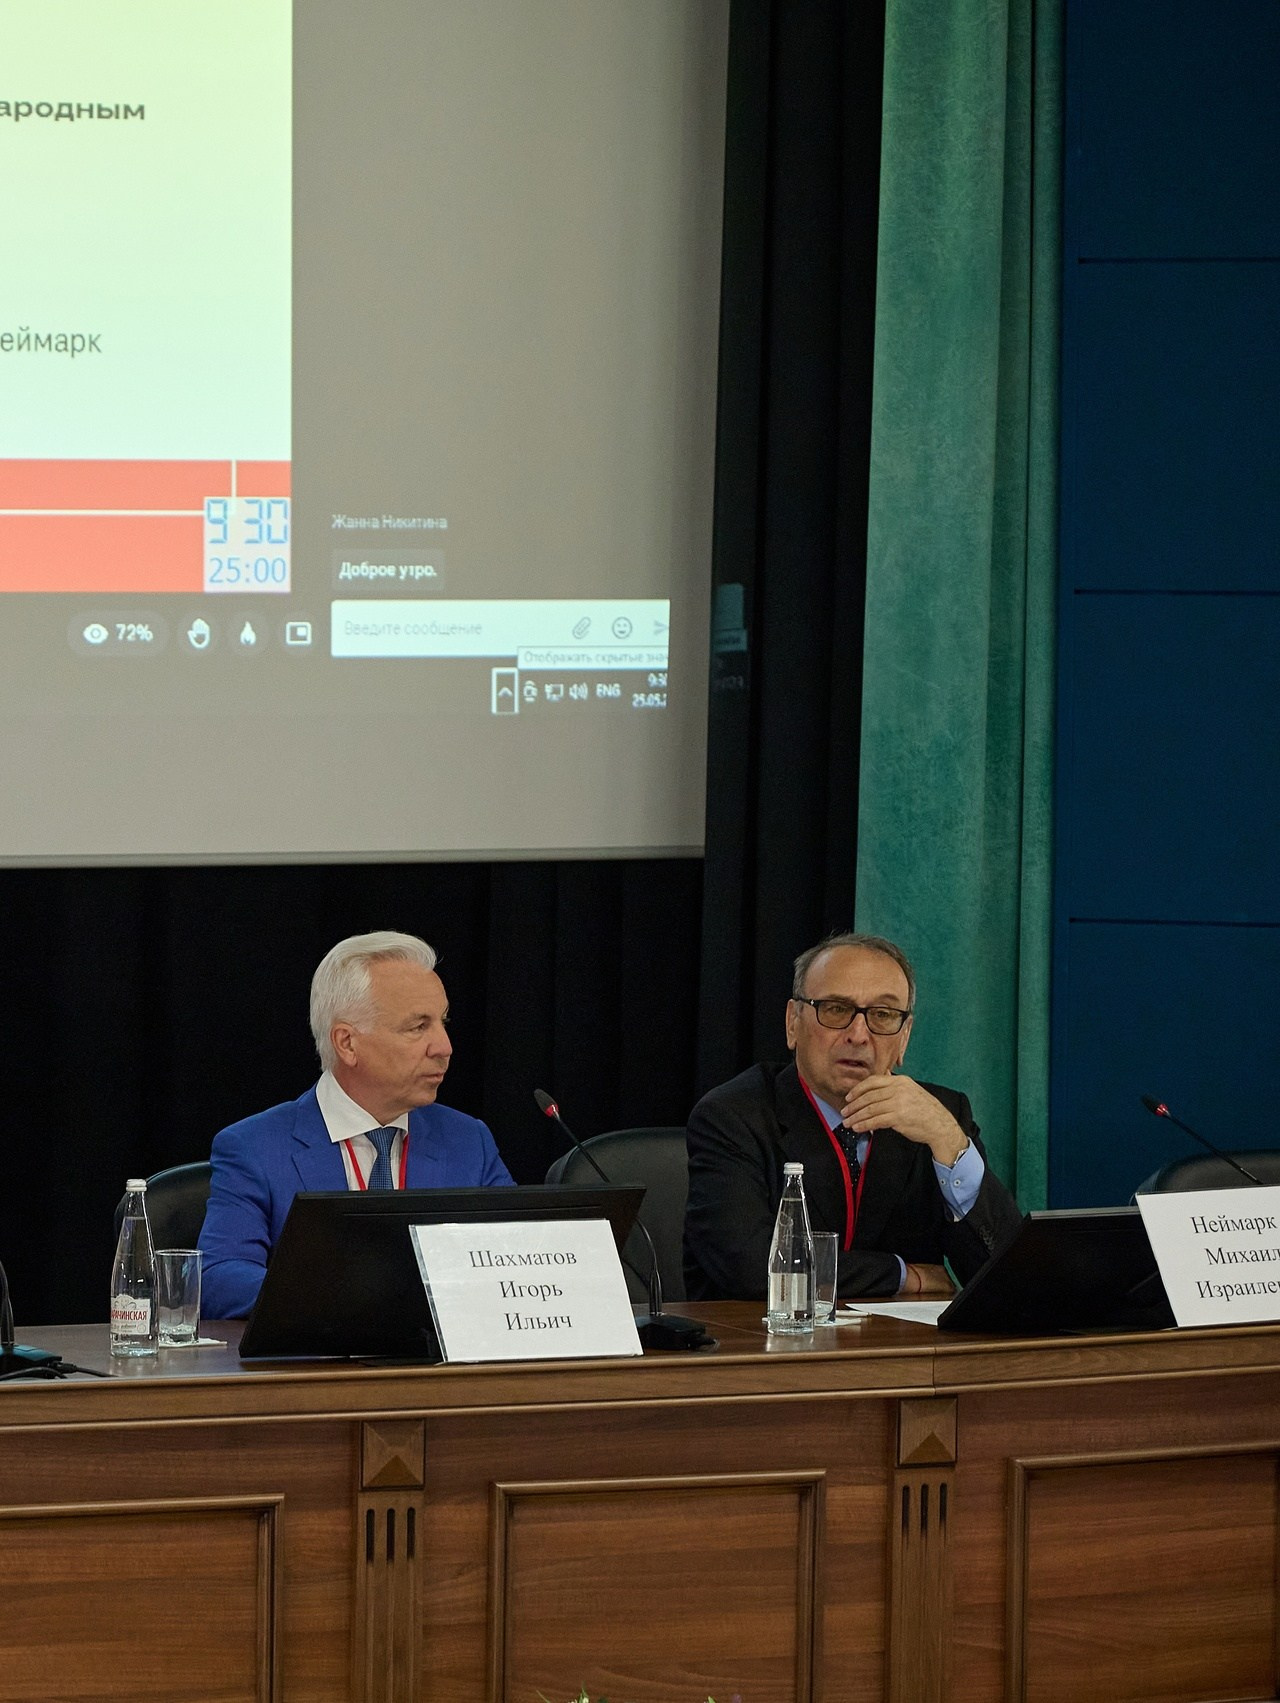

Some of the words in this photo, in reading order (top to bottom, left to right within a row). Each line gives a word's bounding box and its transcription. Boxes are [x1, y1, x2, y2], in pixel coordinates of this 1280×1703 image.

[332, 514, 380, 529] Жанна
[382, 515, 448, 529] Никитина
[209, 556, 287, 584] 25:00
[339, 561, 396, 580] Доброе
[399, 563, 437, 580] утро.
[116, 623, 153, 642] 72%
[345, 620, 401, 636] Введите
[404, 620, 482, 636] сообщение
[524, 651, 592, 664] Отображать
[596, 683, 620, 698] ENG
[1190, 1215, 1277, 1235] Неймарк
[468, 1250, 577, 1268] Шахматов
[498, 1280, 563, 1302] Игорь
[1195, 1280, 1280, 1302] Израиле
[503, 1312, 573, 1331] Ильич
